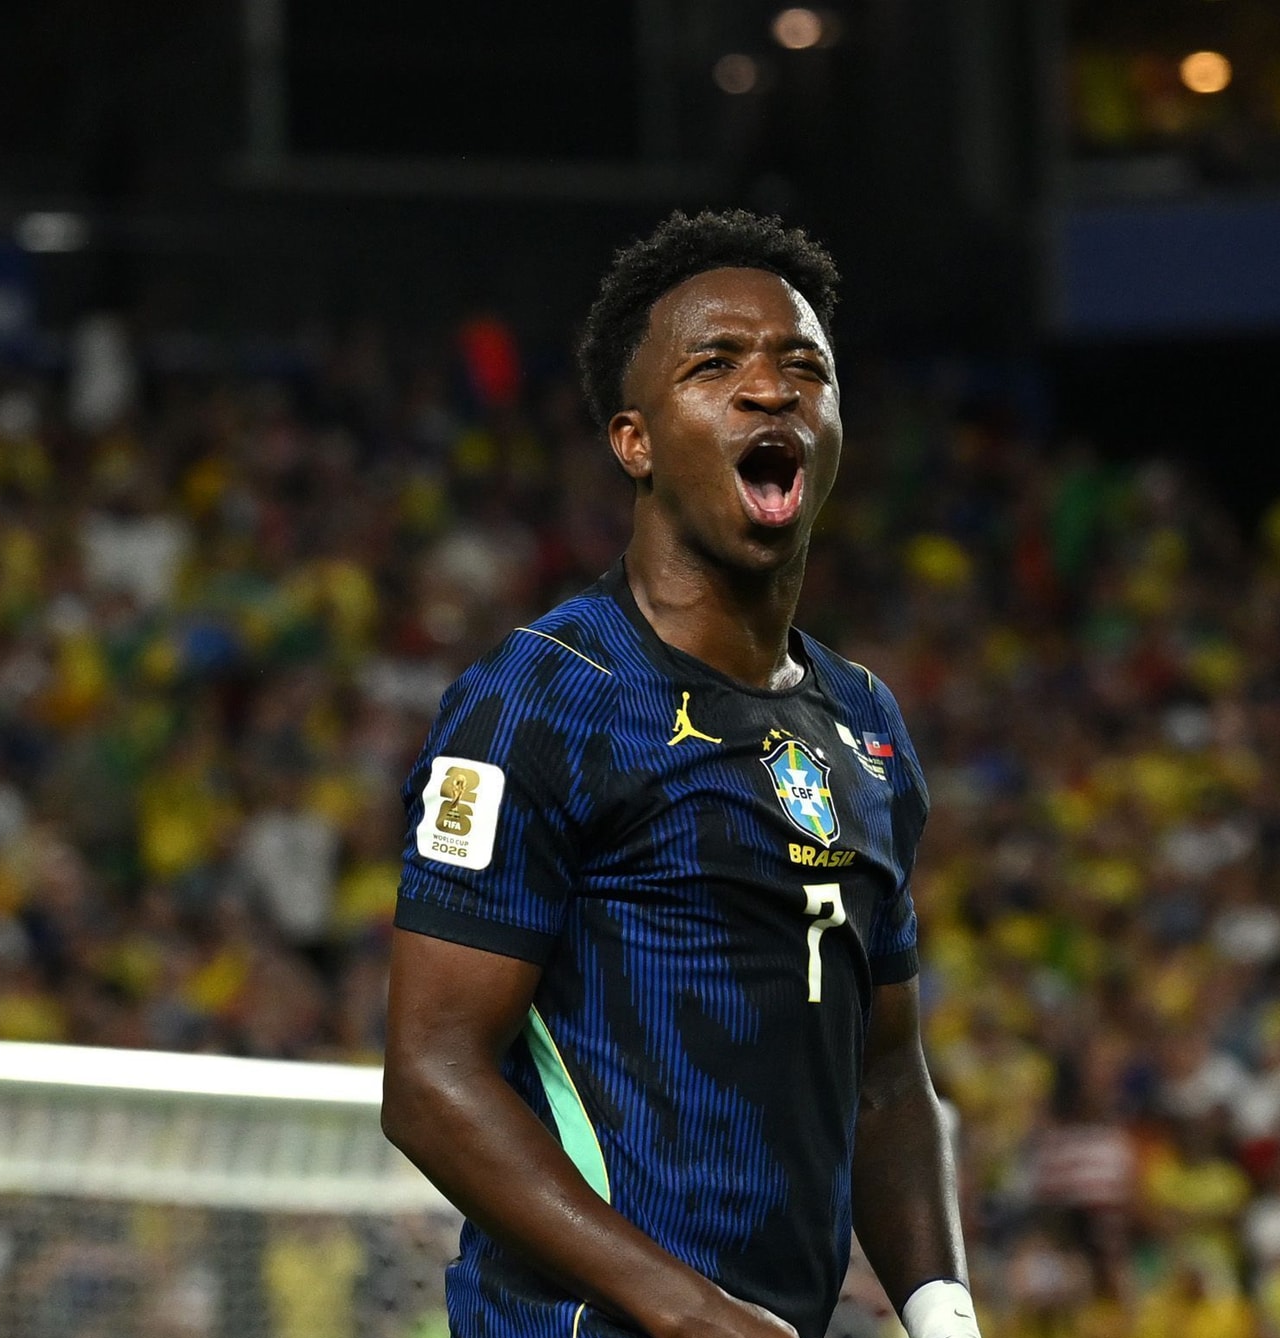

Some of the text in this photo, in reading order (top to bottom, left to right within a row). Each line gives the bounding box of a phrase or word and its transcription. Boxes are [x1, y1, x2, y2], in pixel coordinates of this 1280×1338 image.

[791, 785, 814, 801] CBF
[443, 819, 461, 831] FIFA
[432, 833, 469, 847] WORLD CUP
[431, 841, 468, 858] 2026
[788, 842, 857, 868] BRASIL
[803, 883, 847, 1003] 7
